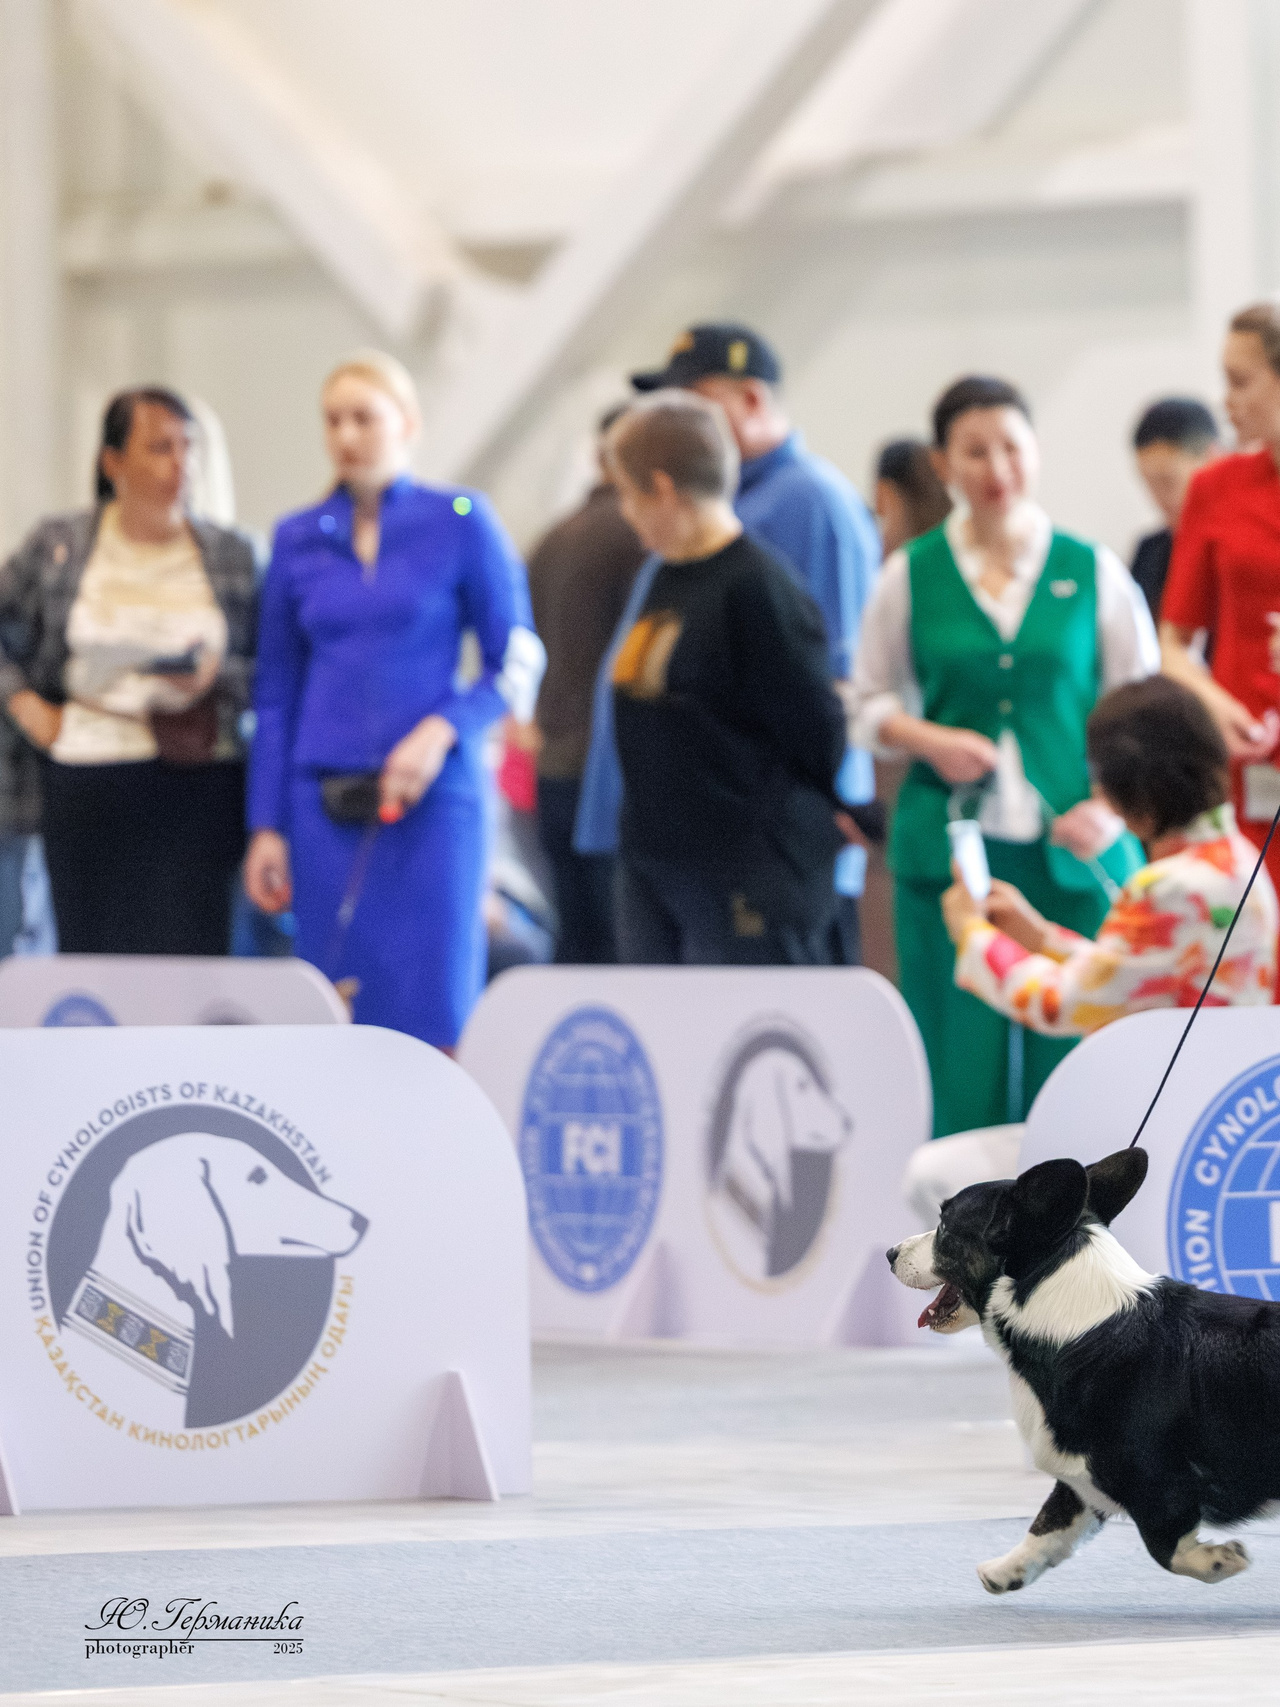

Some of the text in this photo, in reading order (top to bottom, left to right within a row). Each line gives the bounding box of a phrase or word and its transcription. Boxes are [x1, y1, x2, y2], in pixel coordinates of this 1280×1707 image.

[26, 1081, 332, 1312] UNION OF CYNOLOGISTS OF KAZAKHSTAN
[562, 1121, 622, 1175] FCI
